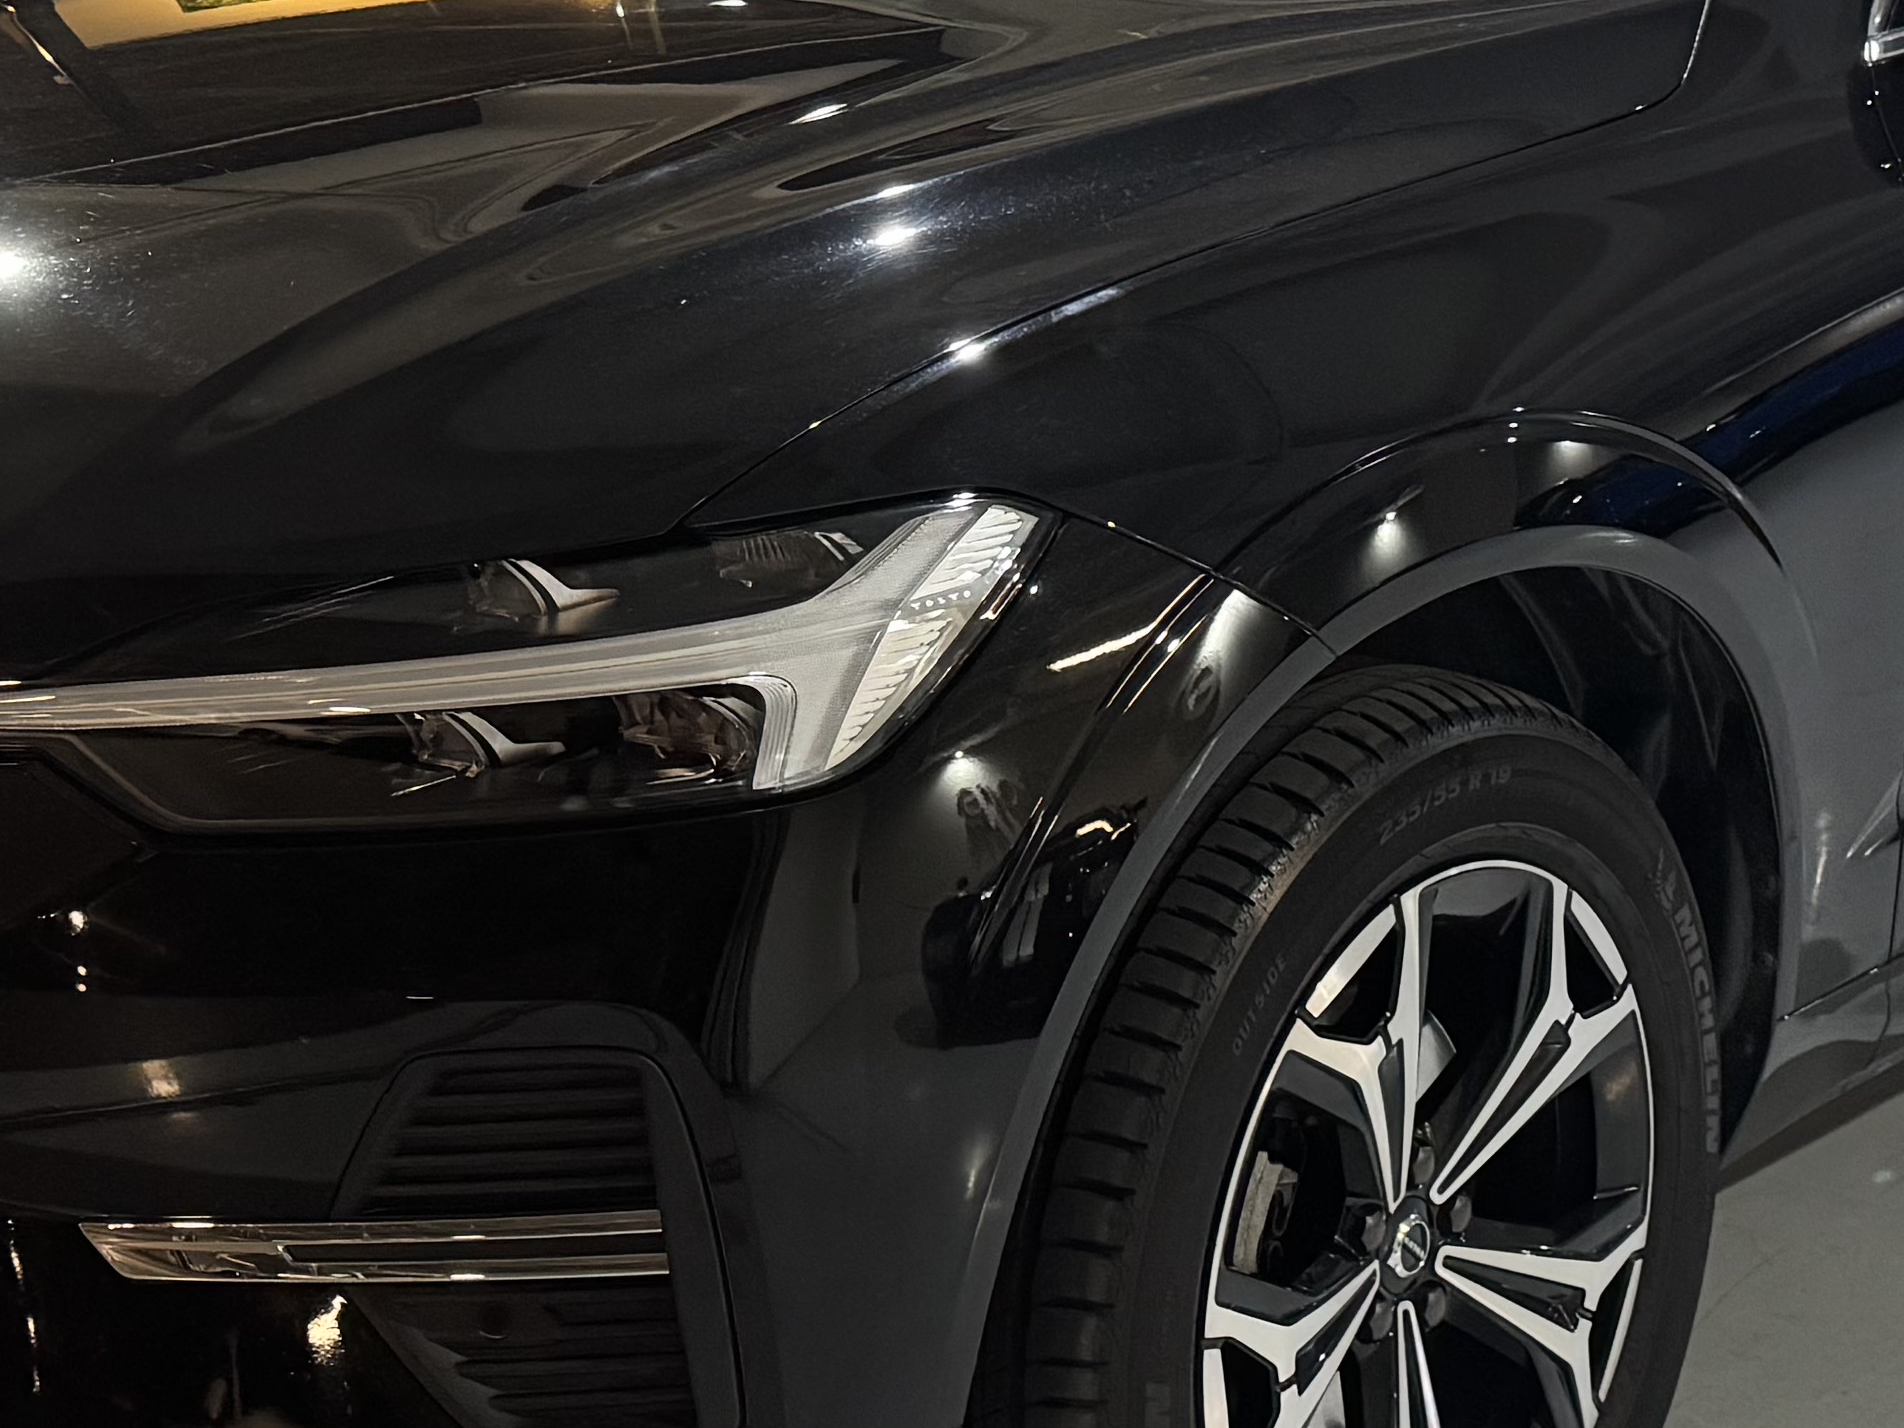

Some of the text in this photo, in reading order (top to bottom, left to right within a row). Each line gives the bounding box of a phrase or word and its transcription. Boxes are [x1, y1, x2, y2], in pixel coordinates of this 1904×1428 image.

[1378, 775, 1461, 847] 235/55
[1231, 952, 1289, 1057] OUTSIDE
[1672, 901, 1722, 1155] MICHELIN
